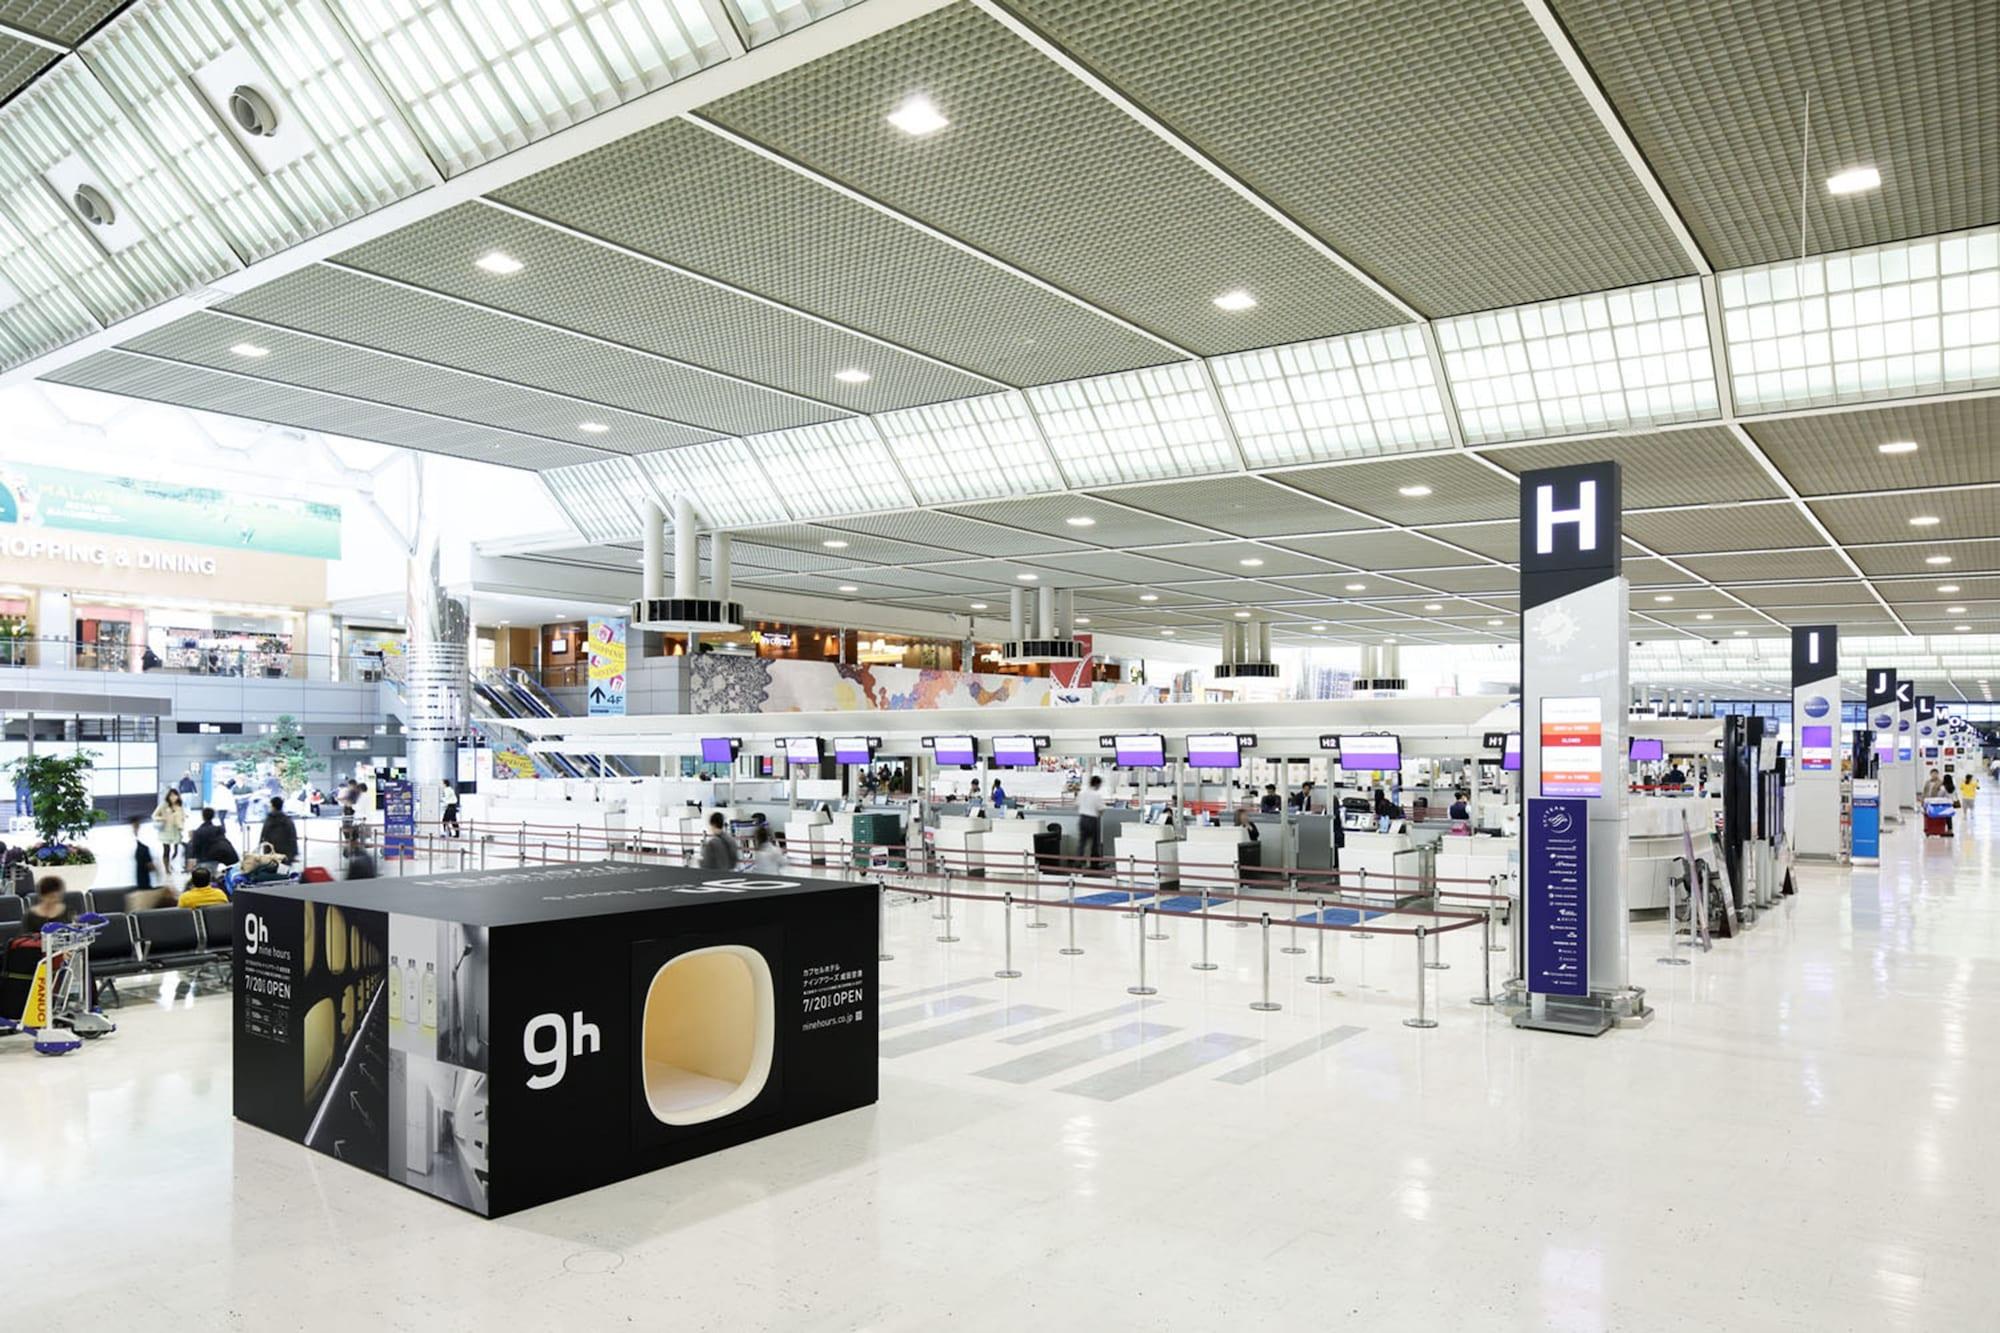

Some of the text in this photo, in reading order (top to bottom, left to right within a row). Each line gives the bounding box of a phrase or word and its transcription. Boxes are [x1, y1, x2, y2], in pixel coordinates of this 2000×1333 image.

[1537, 480, 1596, 554] H
[115, 550, 130, 567] &
[138, 552, 217, 576] DINING
[1809, 632, 1819, 664] I
[1874, 672, 1887, 694] J
[1896, 683, 1910, 702] K
[607, 695, 623, 705] 4F
[1920, 698, 1932, 713] L
[1935, 706, 1949, 721] M
[1101, 738, 1113, 746] H4
[1322, 738, 1336, 747] H2
[1488, 737, 1503, 746] H1
[245, 913, 268, 955] 9h
[245, 975, 262, 993] 7/20
[266, 980, 291, 1000] OPEN
[37, 977, 46, 1022] FANUC
[803, 995, 828, 1013] 7/20
[833, 988, 863, 1006] OPEN
[523, 1010, 601, 1090] 9h
